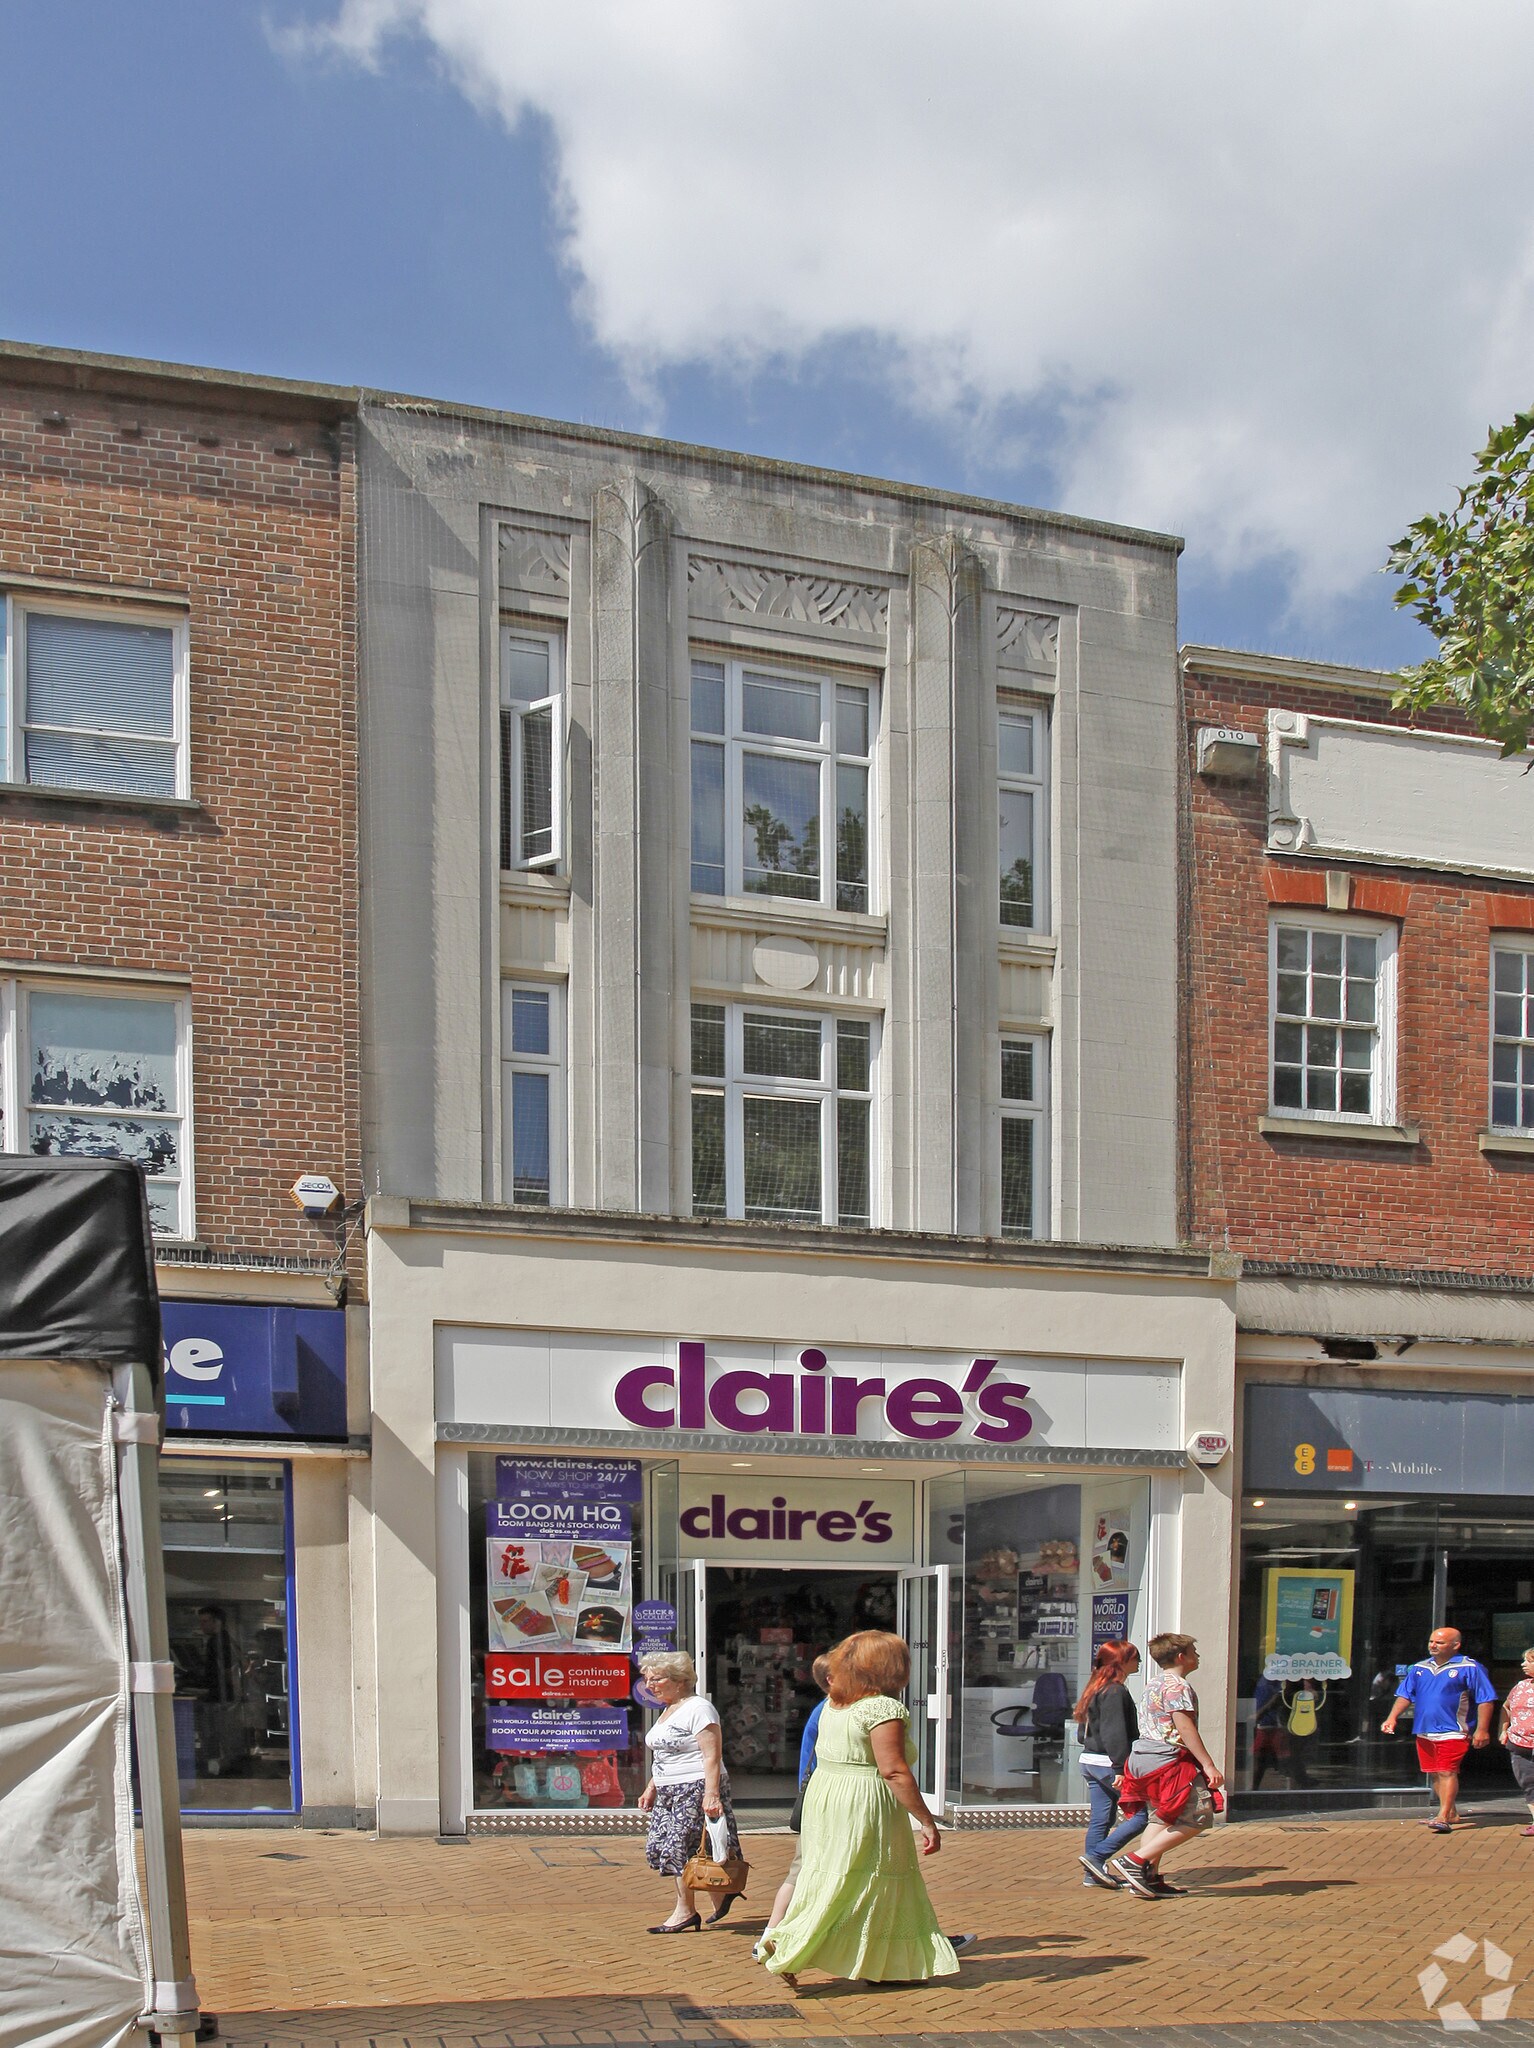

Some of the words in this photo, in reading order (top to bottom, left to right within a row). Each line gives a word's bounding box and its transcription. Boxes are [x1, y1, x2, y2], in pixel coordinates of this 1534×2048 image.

[301, 1181, 331, 1190] SECOM
[162, 1338, 224, 1381] e
[613, 1341, 1034, 1443] claire's
[500, 1458, 637, 1471] www.claires.co.uk
[516, 1470, 554, 1480] NOW
[558, 1471, 593, 1481] SHOP
[597, 1472, 627, 1483] 24/7
[497, 1503, 574, 1520] LOOM
[583, 1505, 622, 1522] HQ
[680, 1494, 893, 1544] claire's
[1094, 1603, 1126, 1615] WORLD
[1093, 1621, 1124, 1632] RECORD
[1291, 1659, 1342, 1668] BRAINER
[491, 1656, 565, 1687] sale
[568, 1666, 626, 1677] continues
[531, 1709, 581, 1720] claire's
